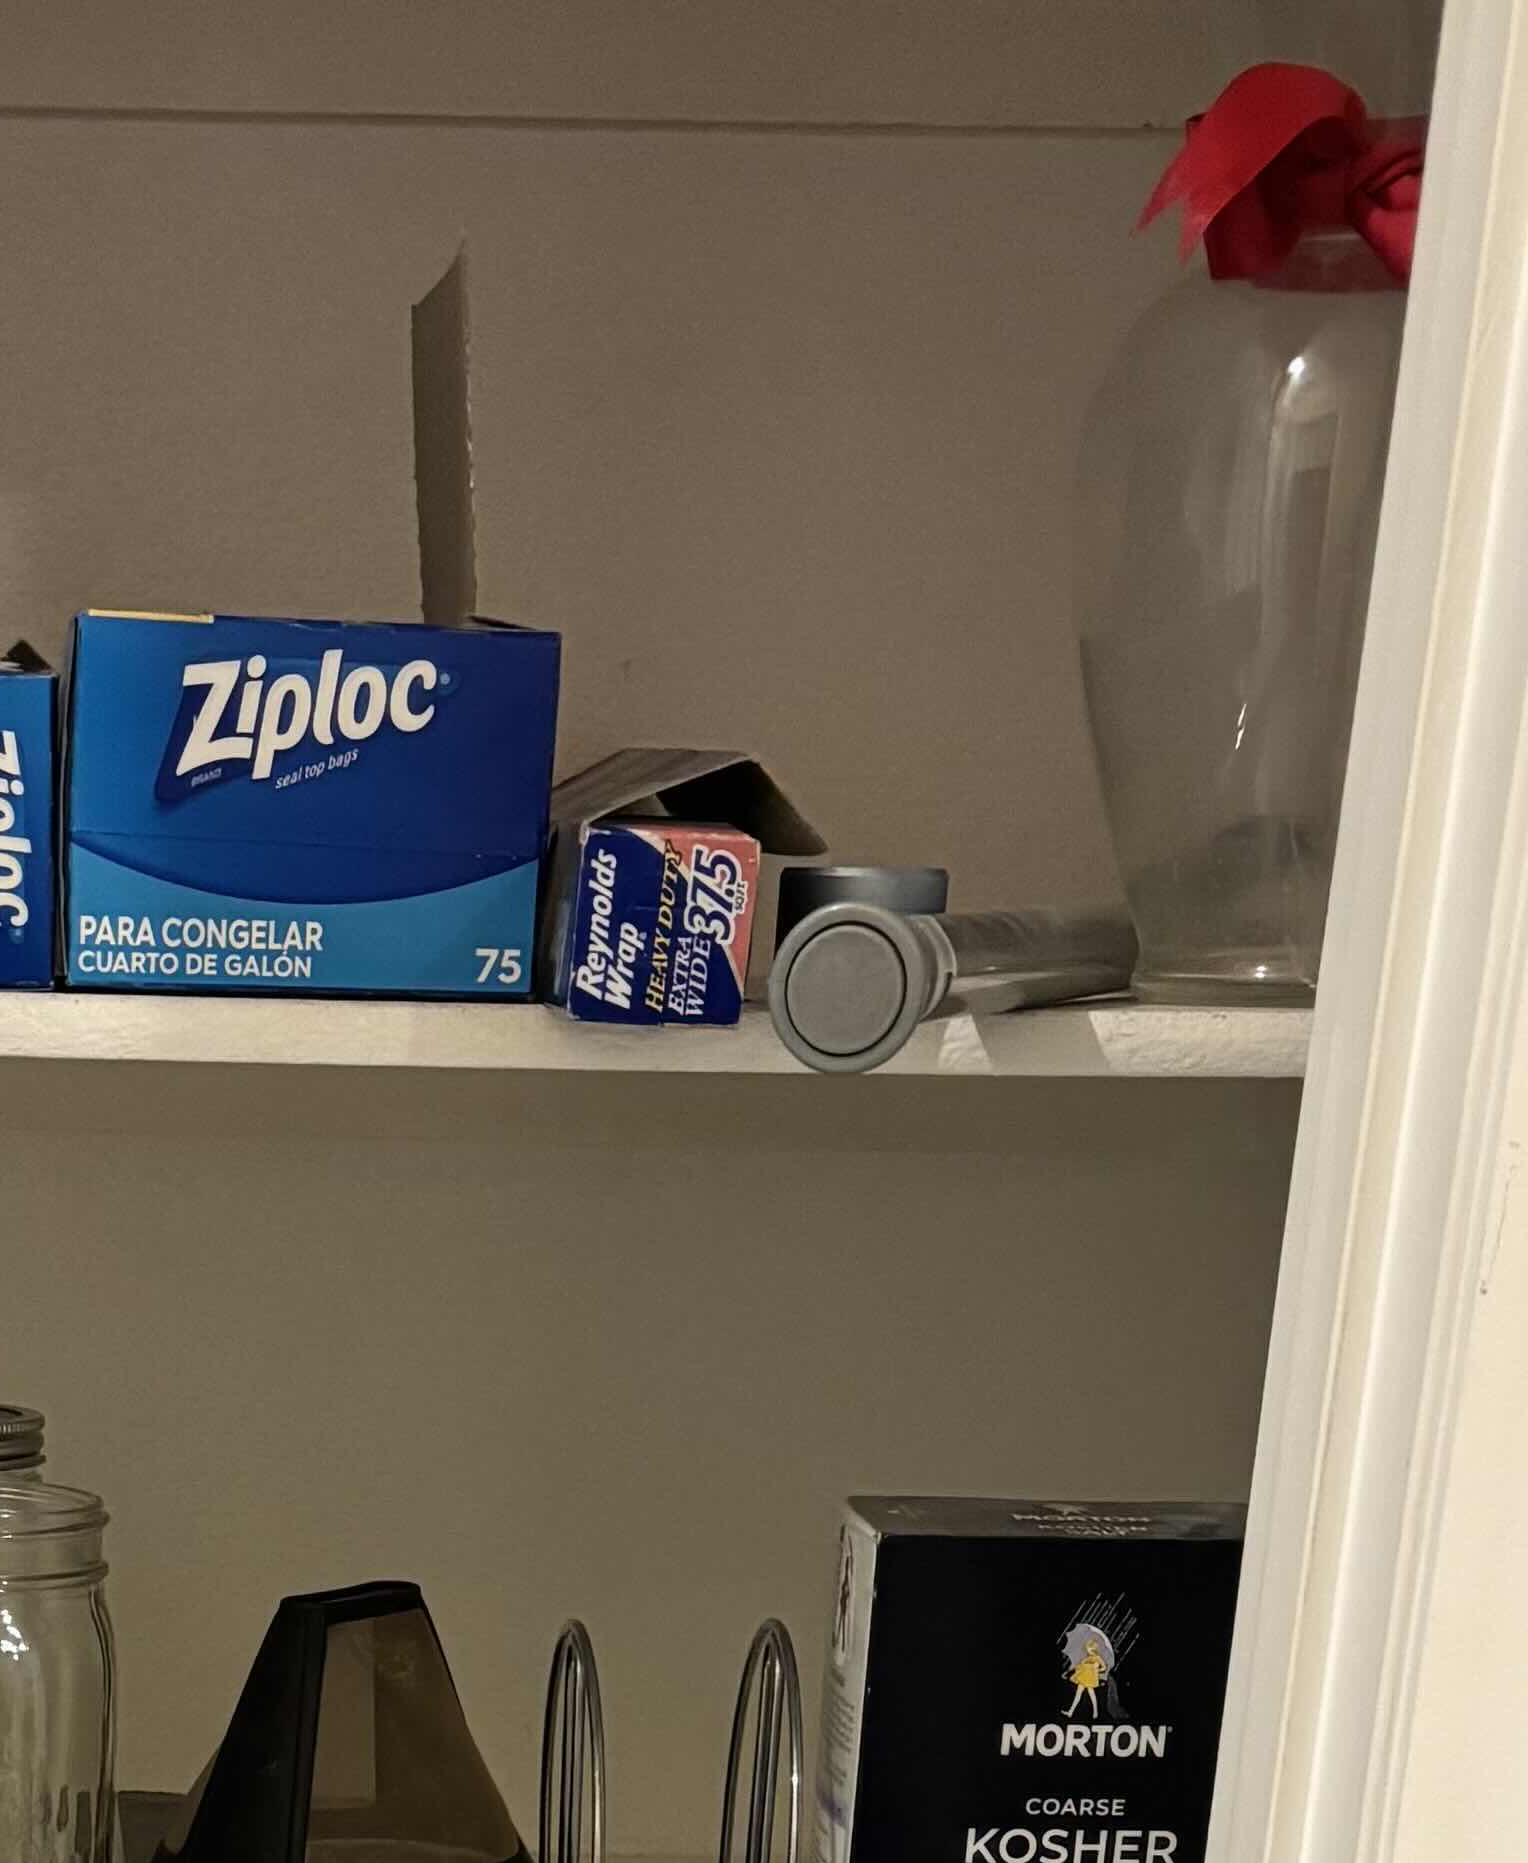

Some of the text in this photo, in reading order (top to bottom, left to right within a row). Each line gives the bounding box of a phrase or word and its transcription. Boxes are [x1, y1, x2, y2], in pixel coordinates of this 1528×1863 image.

[175, 648, 437, 780] Ziploc
[275, 746, 360, 790] seal top bags
[78, 915, 324, 952] PARA CONGELAR
[575, 849, 618, 1001] Reynolds
[644, 839, 683, 1013] HEAVY DUTY
[77, 948, 312, 978] CUARTO DE GALÓN
[474, 948, 522, 984] 75
[604, 921, 646, 1010] Wrap
[668, 935, 693, 1016] EXTRA
[684, 934, 712, 1017] WIDE
[999, 1723, 1167, 1758] MORTON
[1024, 1797, 1127, 1816] COARSE
